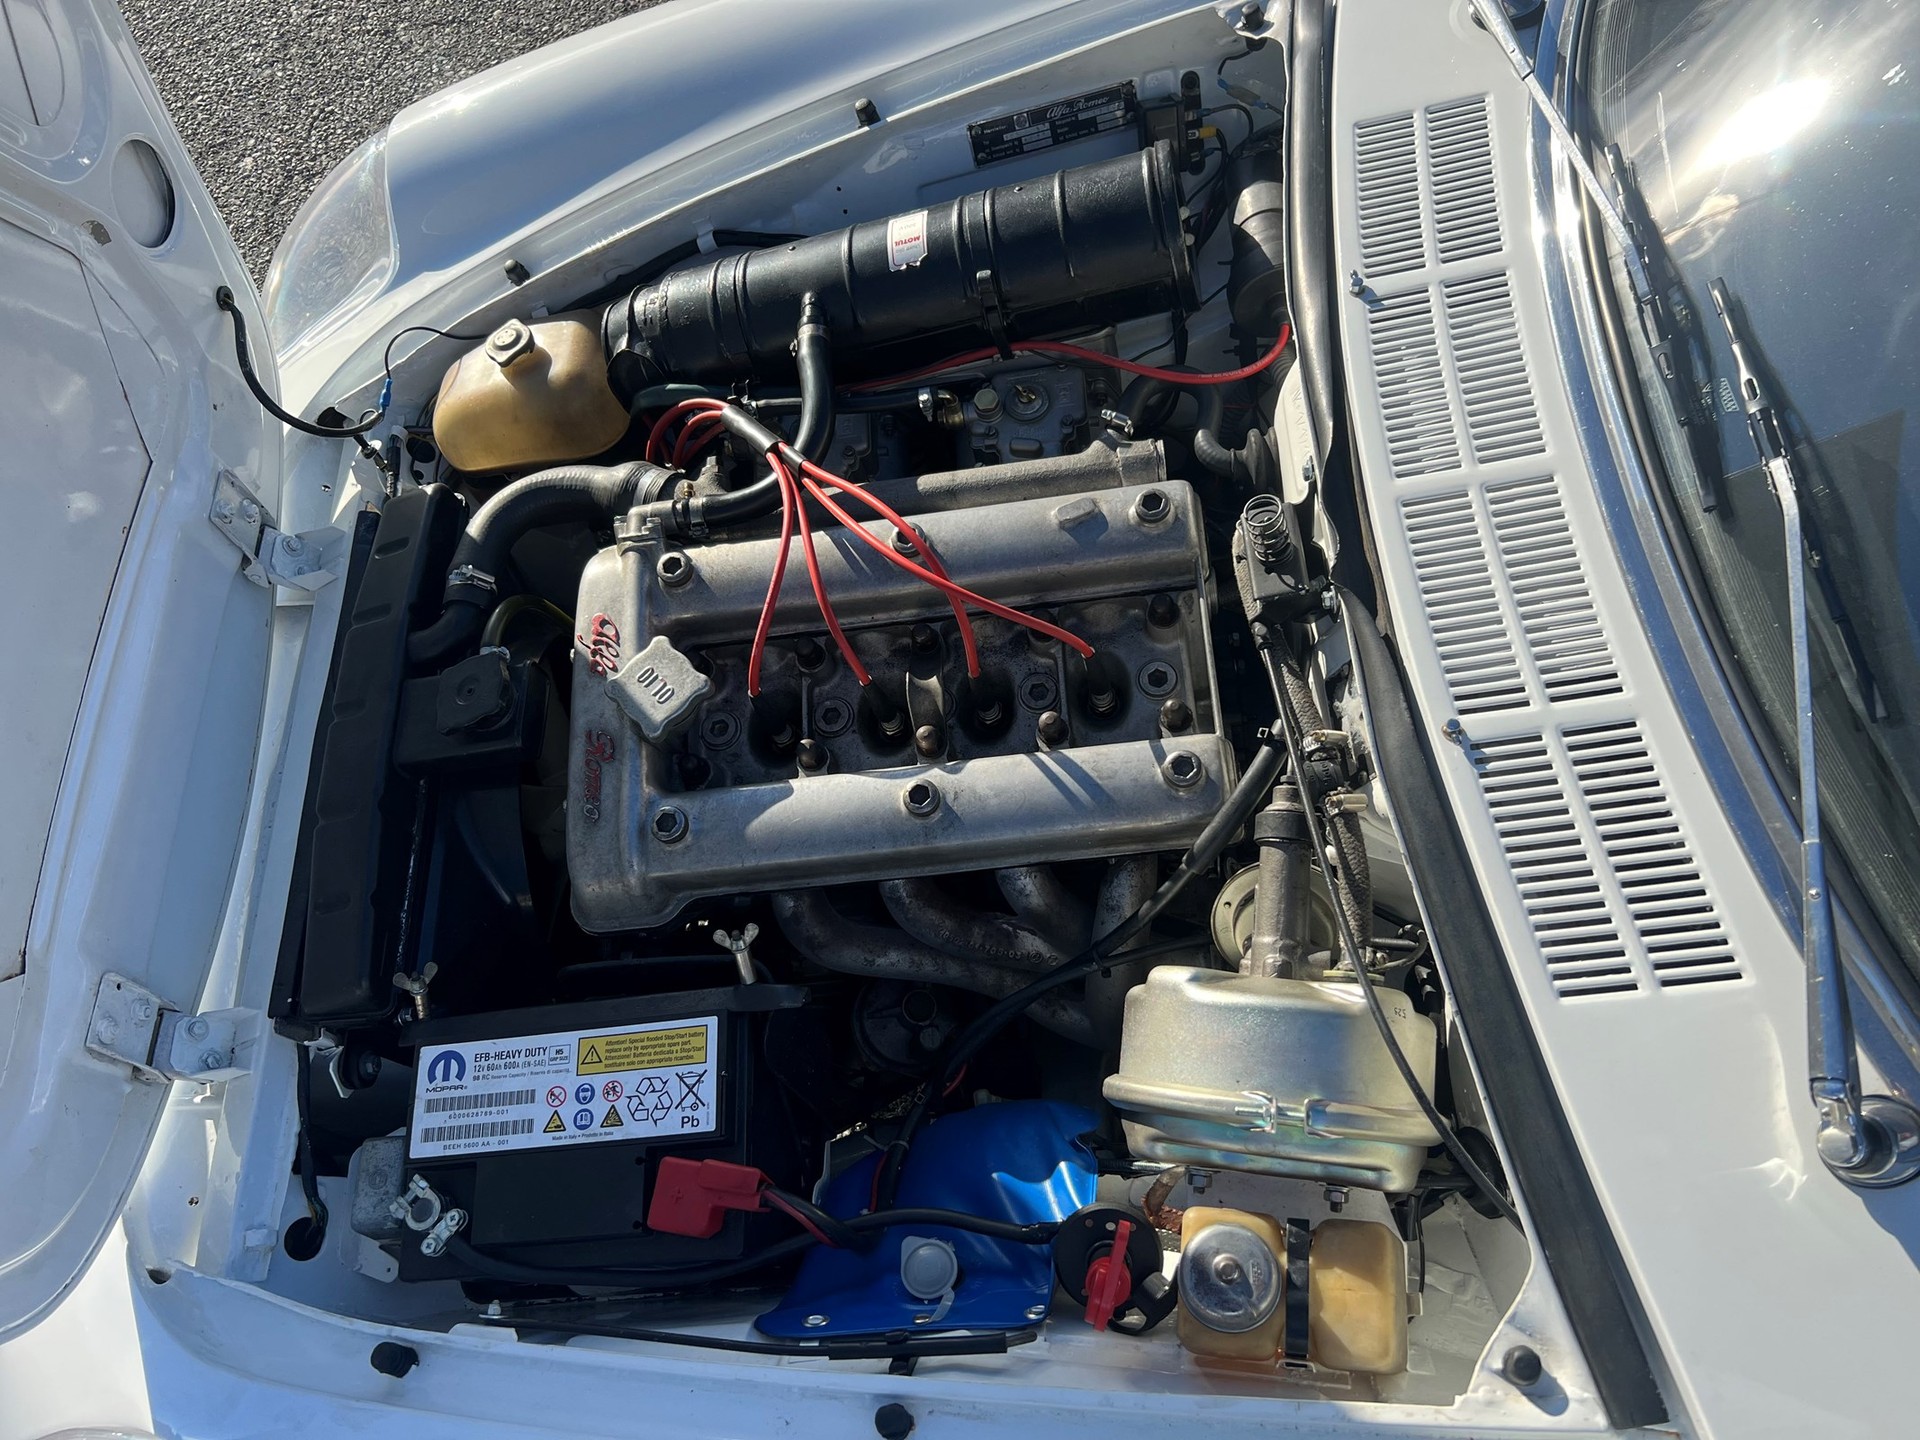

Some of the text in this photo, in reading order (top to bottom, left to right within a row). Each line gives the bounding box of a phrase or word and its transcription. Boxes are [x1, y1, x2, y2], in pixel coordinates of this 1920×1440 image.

[1046, 103, 1072, 119] Alfa
[1073, 96, 1110, 112] Romeo
[894, 235, 921, 247] MOTUL
[577, 613, 621, 677] Alfa
[637, 665, 675, 705] OLIO
[583, 730, 615, 822] Romeo
[605, 1038, 628, 1046] Attention!
[628, 1036, 645, 1044] Special
[664, 1032, 687, 1041] Stop/Start
[474, 1047, 548, 1063] EFB-HEAVY DUTY
[555, 1048, 564, 1056] H5
[604, 1053, 632, 1061] Attenzione!
[633, 1051, 652, 1059] Batteria
[679, 1046, 704, 1054] Stop/Start
[486, 1062, 502, 1072] 60Ah
[503, 1061, 520, 1070] 600A
[521, 1059, 547, 1069] (EN-SAE)
[681, 1115, 700, 1128] Pb
[463, 1141, 479, 1149] 5600
